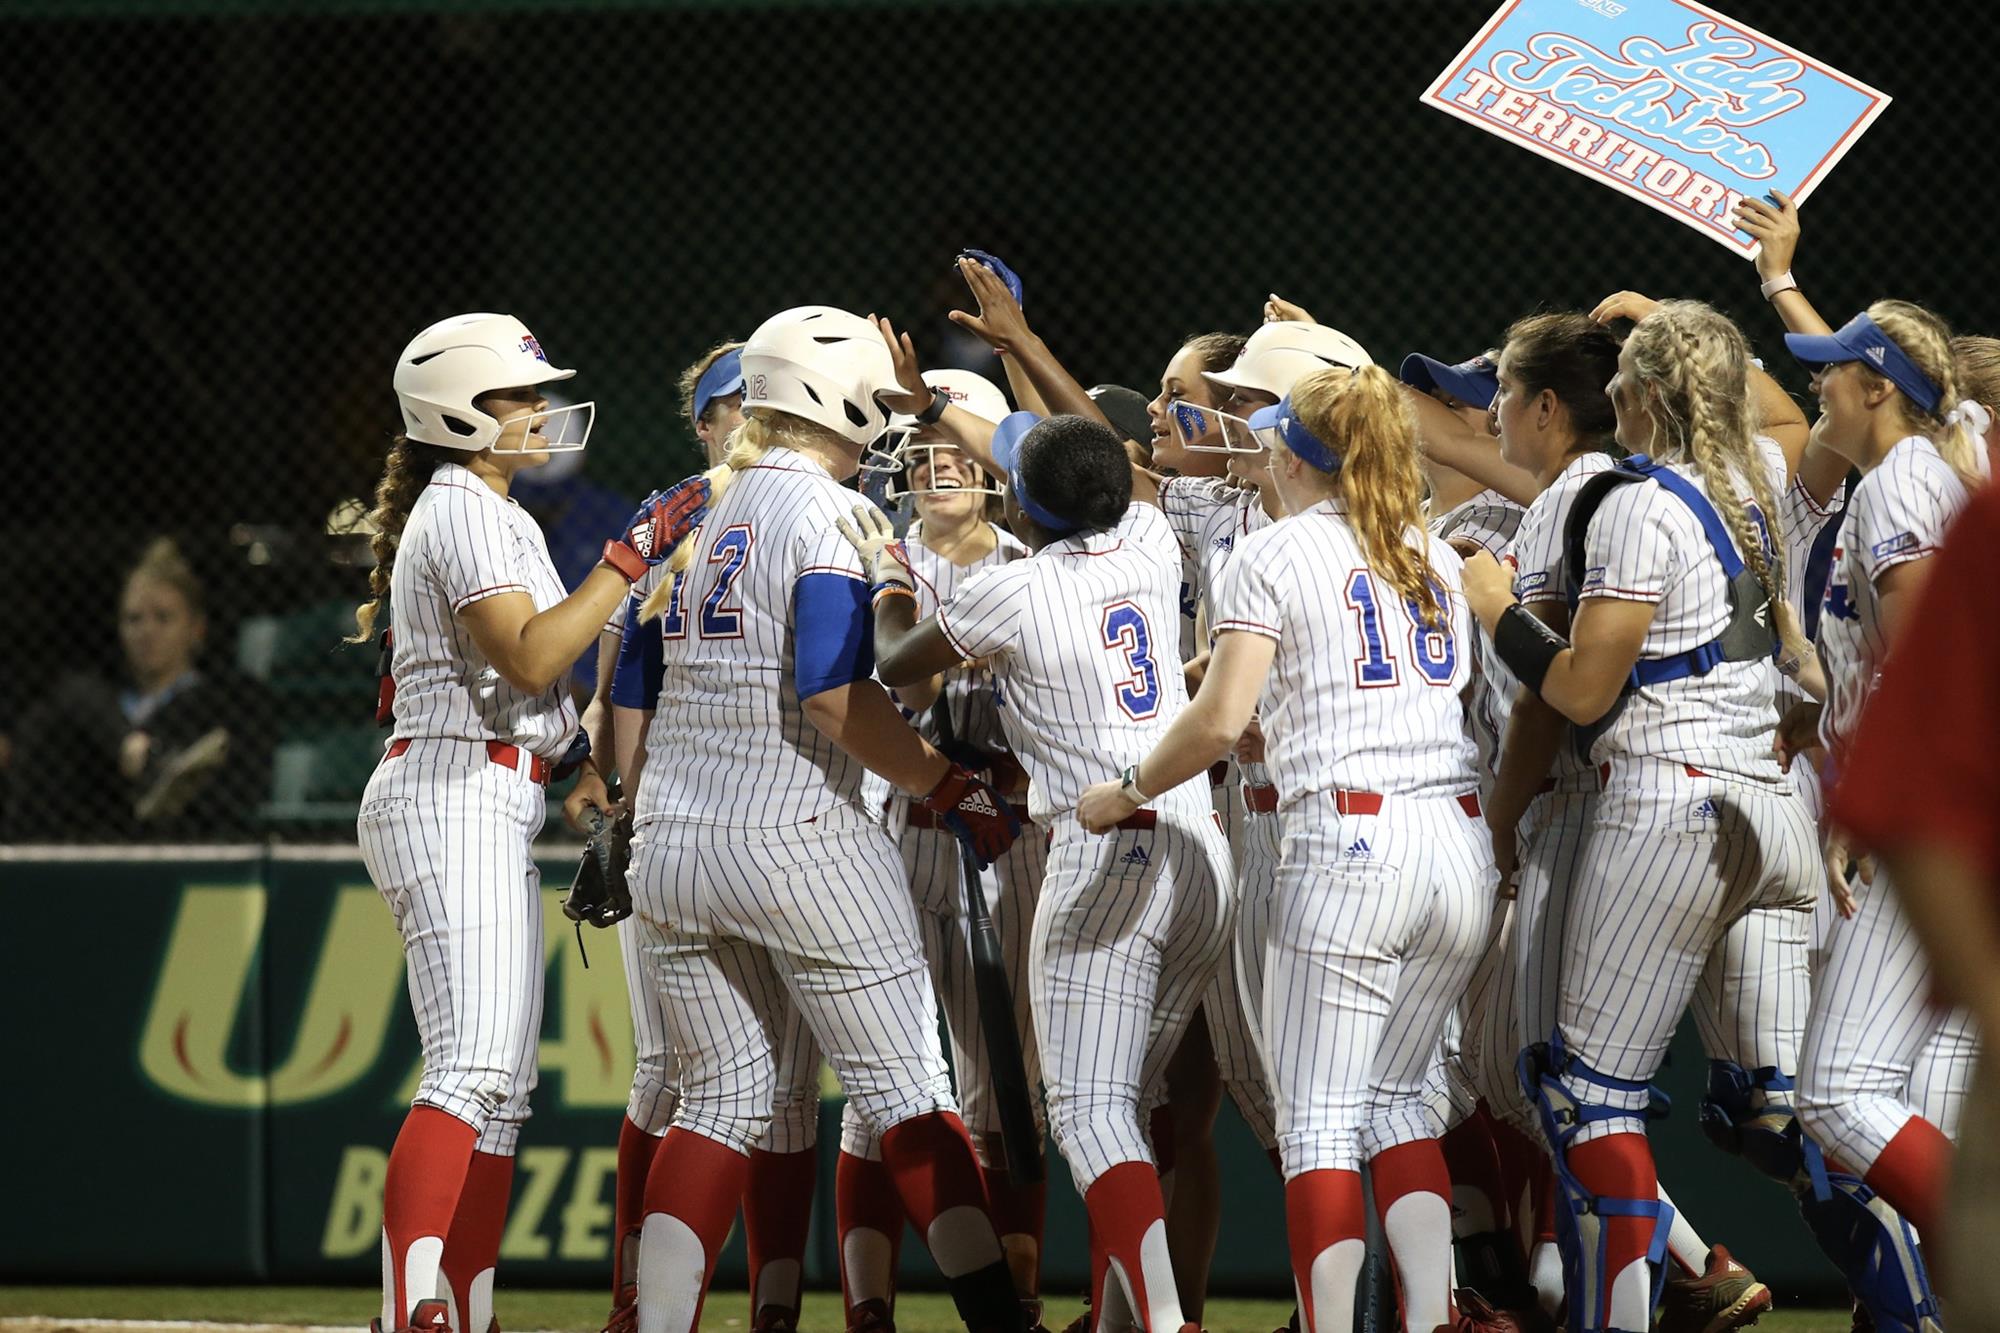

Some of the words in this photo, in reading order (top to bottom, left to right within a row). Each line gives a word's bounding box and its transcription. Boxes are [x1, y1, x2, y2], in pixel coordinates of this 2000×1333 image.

[1489, 32, 1778, 179] Techsters
[1619, 21, 1807, 125] Lady
[750, 374, 767, 400] 12
[642, 517, 657, 558] adidas
[1100, 599, 1163, 722] 3
[958, 802, 998, 817] adidas
